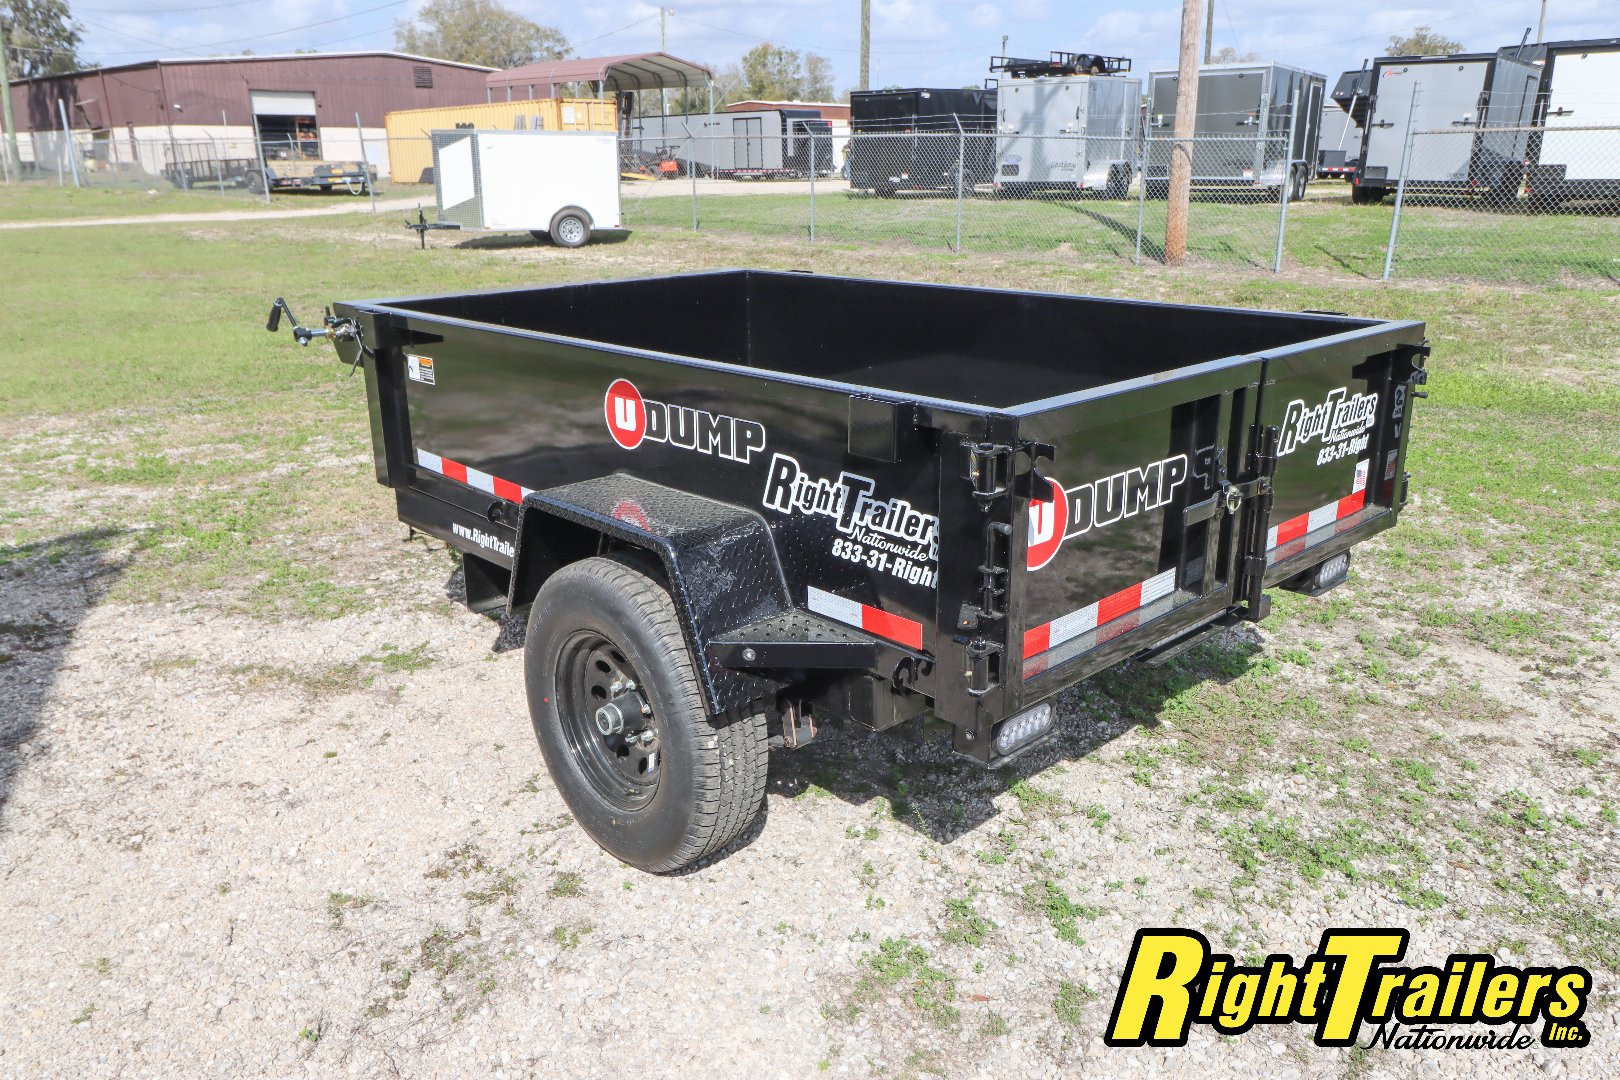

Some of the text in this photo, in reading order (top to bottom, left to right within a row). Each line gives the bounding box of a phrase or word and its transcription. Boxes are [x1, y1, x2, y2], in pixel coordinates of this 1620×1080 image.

[1276, 386, 1378, 457] RightTrailers
[1327, 421, 1366, 445] Nationwide
[1316, 433, 1369, 466] 833-31-Right
[847, 525, 929, 562] Nationwide
